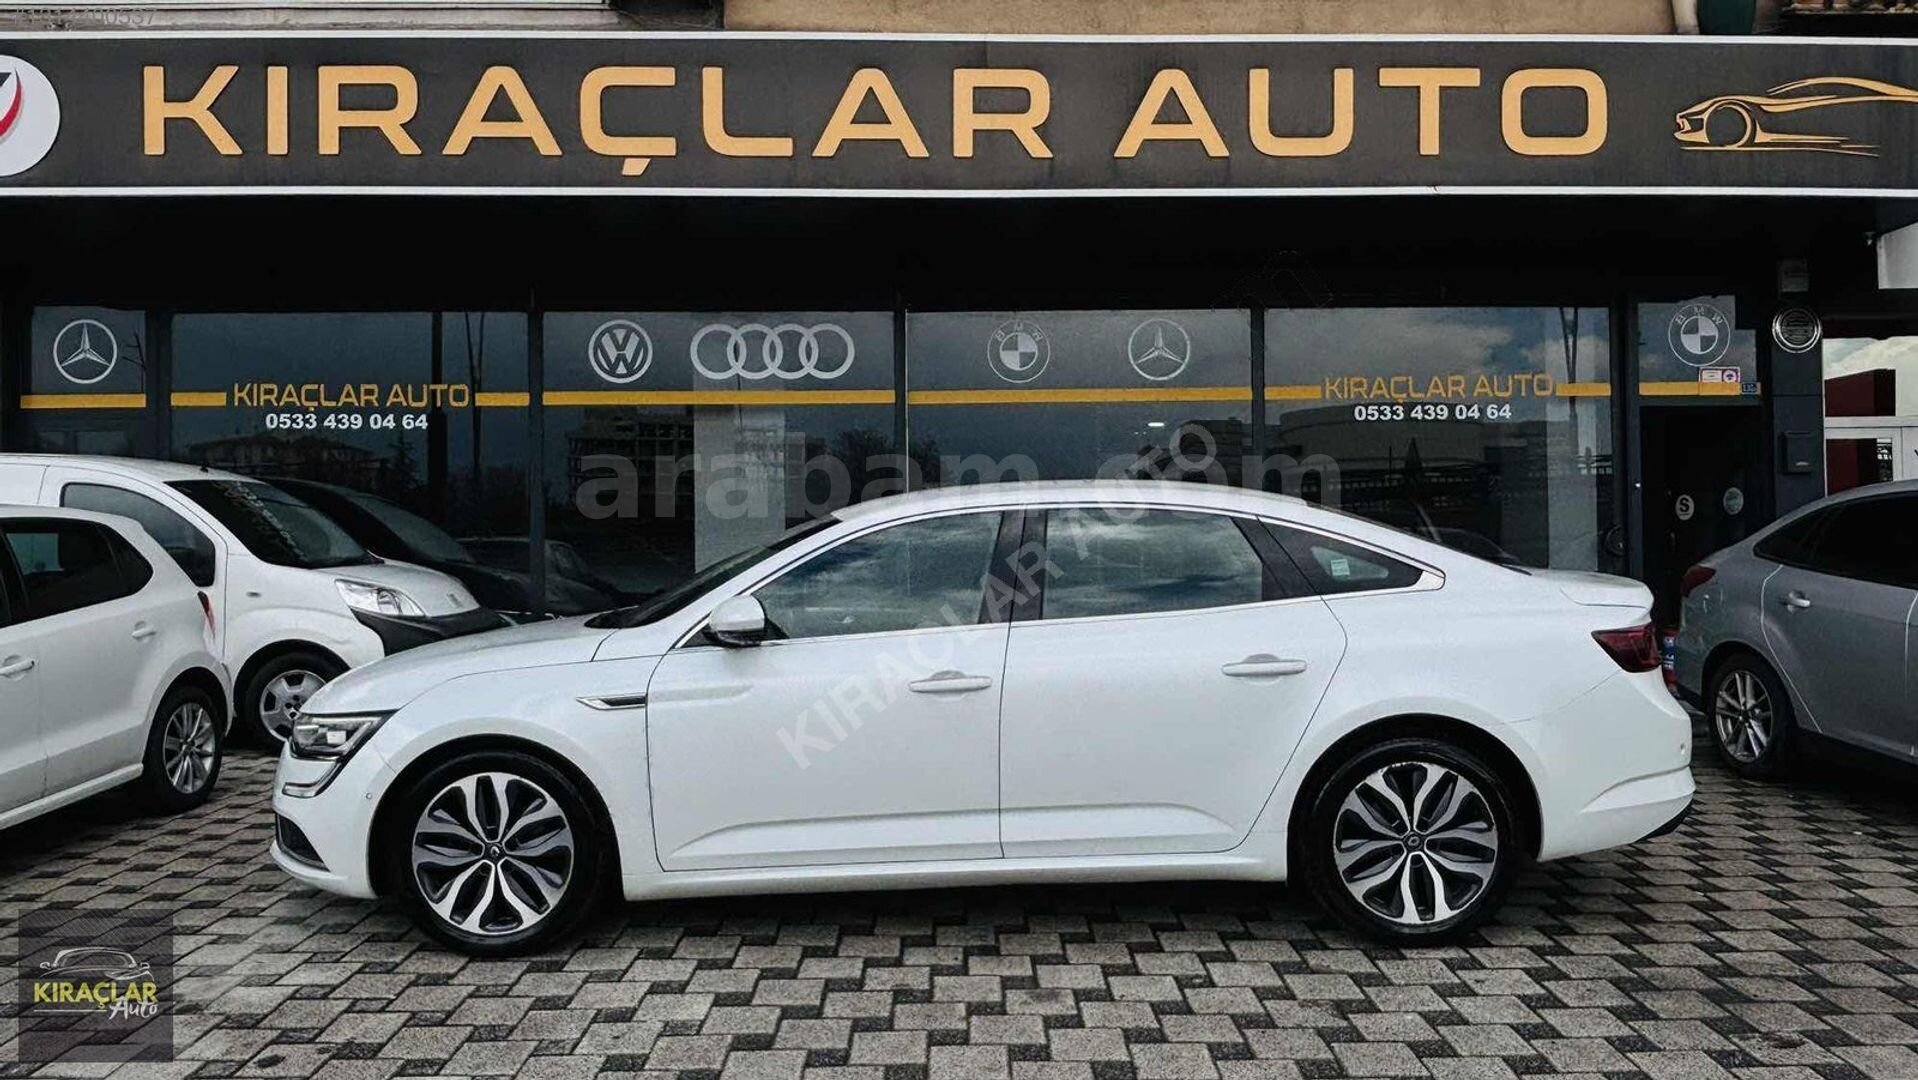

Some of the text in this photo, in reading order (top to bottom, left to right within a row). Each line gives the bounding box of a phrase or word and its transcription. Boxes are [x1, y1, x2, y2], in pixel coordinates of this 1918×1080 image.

[143, 64, 1608, 176] KIRAÇLAR AUTO
[233, 383, 470, 411] KIRAÇLAR AUTO
[1325, 372, 1552, 402] KIRAÇLAR AUTO
[265, 413, 429, 430] 0533 439 04 64
[1353, 403, 1513, 421] 0533 439 04 64
[1679, 497, 1690, 513] S
